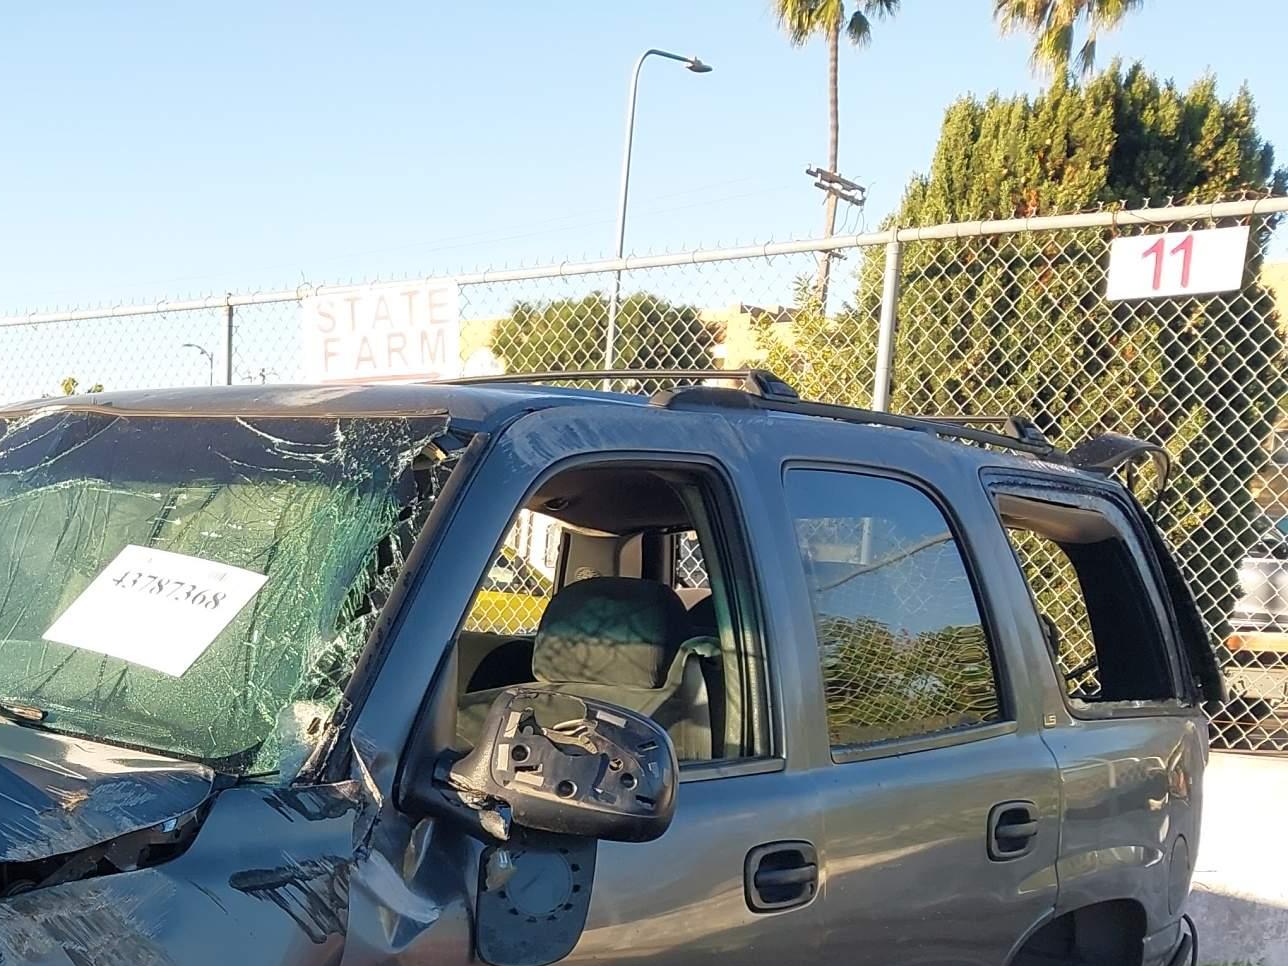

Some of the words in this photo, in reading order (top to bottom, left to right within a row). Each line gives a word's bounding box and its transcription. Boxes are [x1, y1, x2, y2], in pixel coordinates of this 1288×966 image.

[1141, 234, 1194, 290] 11
[316, 288, 450, 334] STATE
[323, 328, 447, 372] FARM
[112, 570, 227, 610] 43787368
